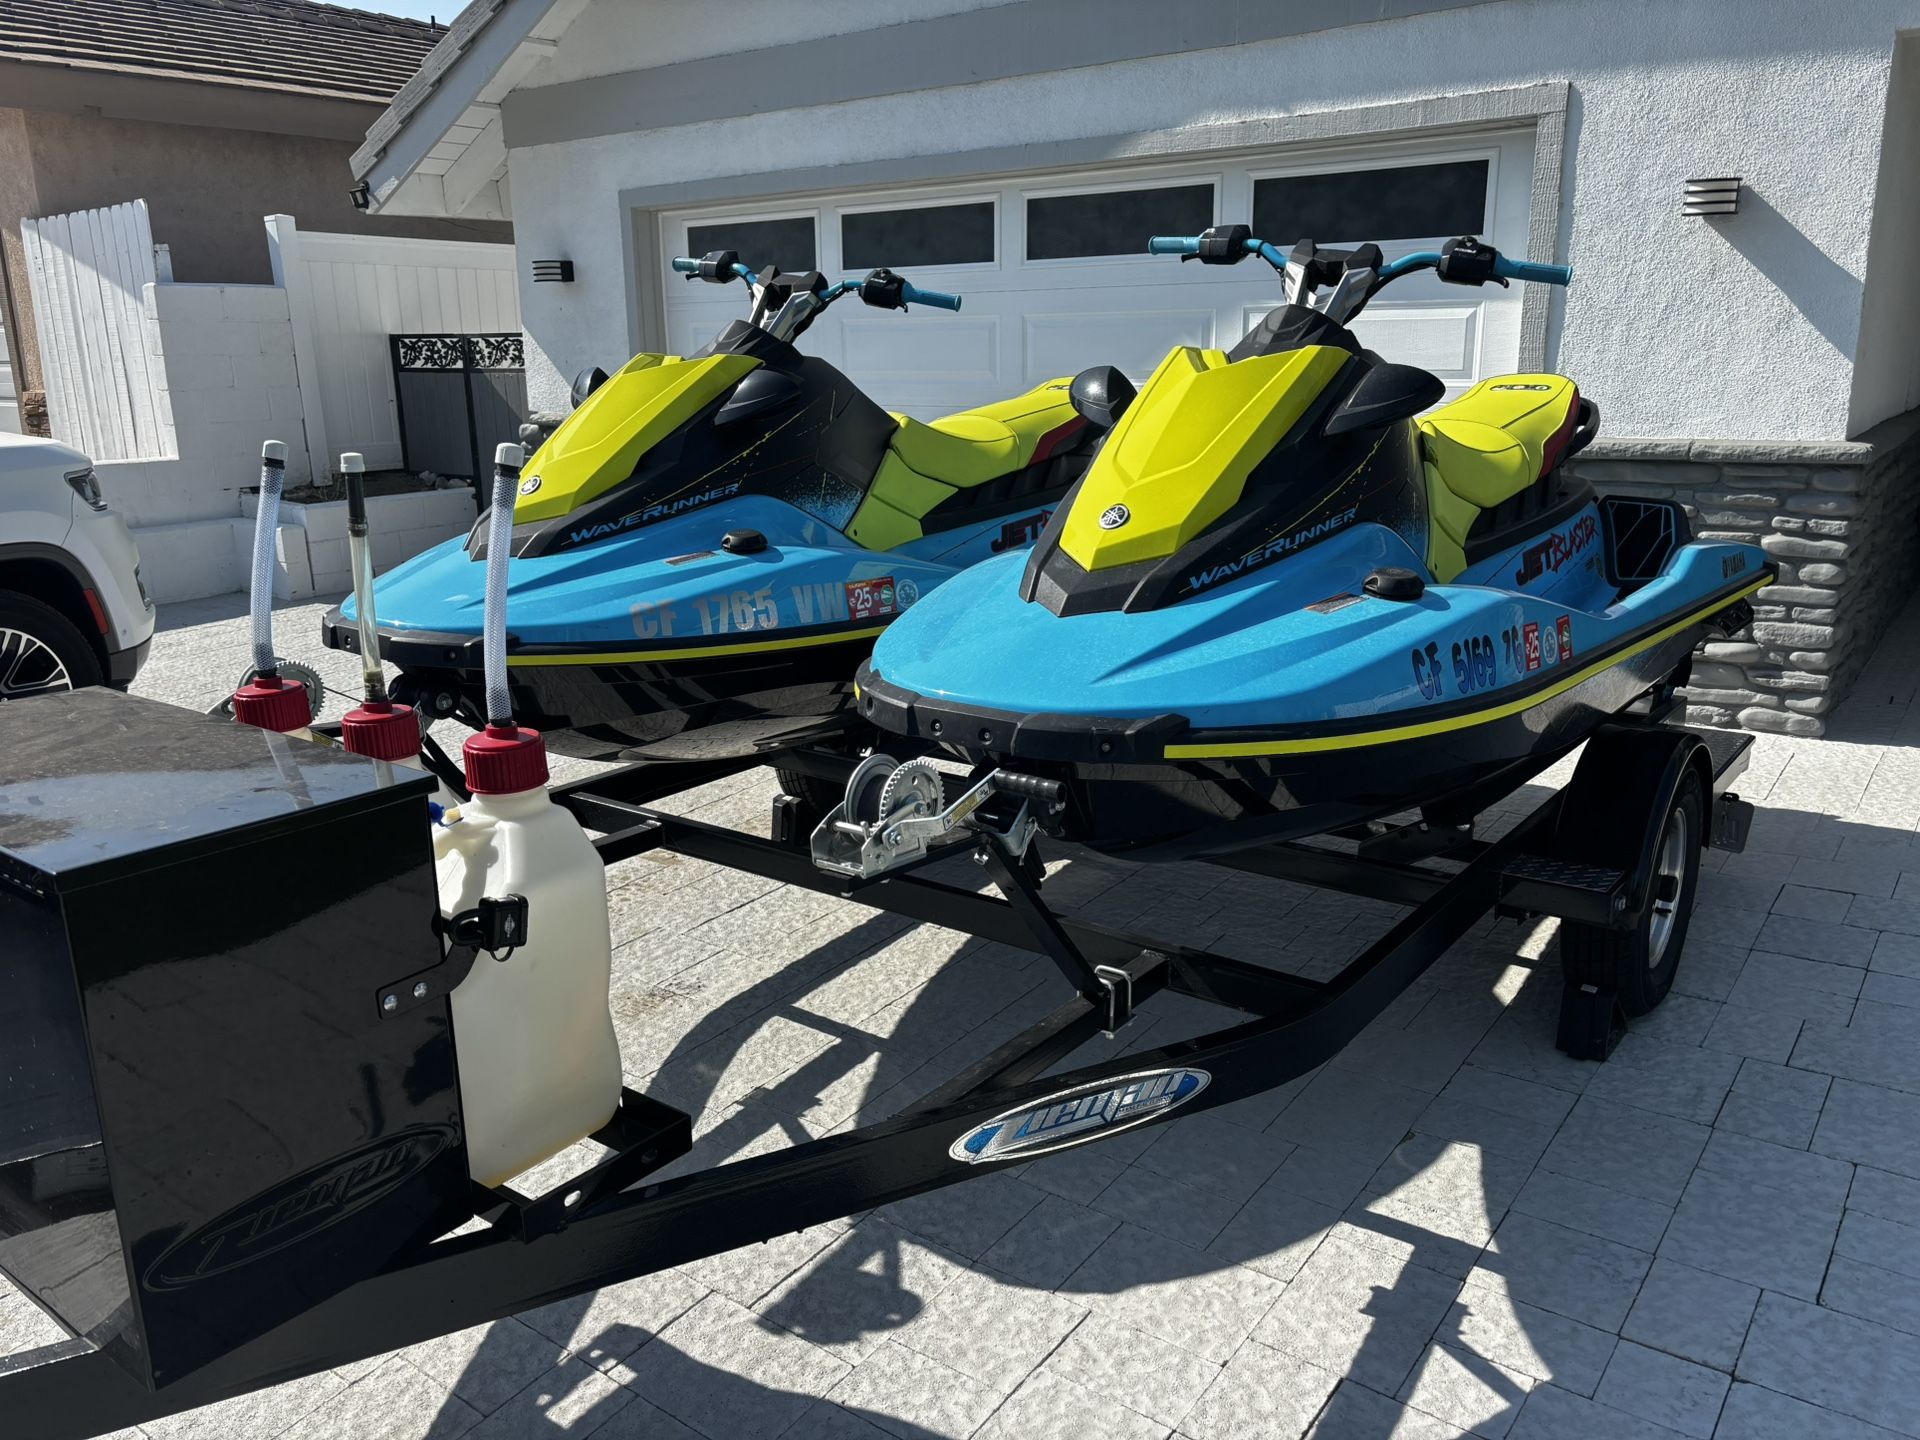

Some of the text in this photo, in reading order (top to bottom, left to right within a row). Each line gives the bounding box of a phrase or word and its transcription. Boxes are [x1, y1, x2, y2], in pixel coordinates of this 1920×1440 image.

[629, 582, 848, 638] CF 1765 VW
[855, 587, 873, 609] 25
[1529, 631, 1540, 659] 25
[1411, 641, 1442, 700] CF
